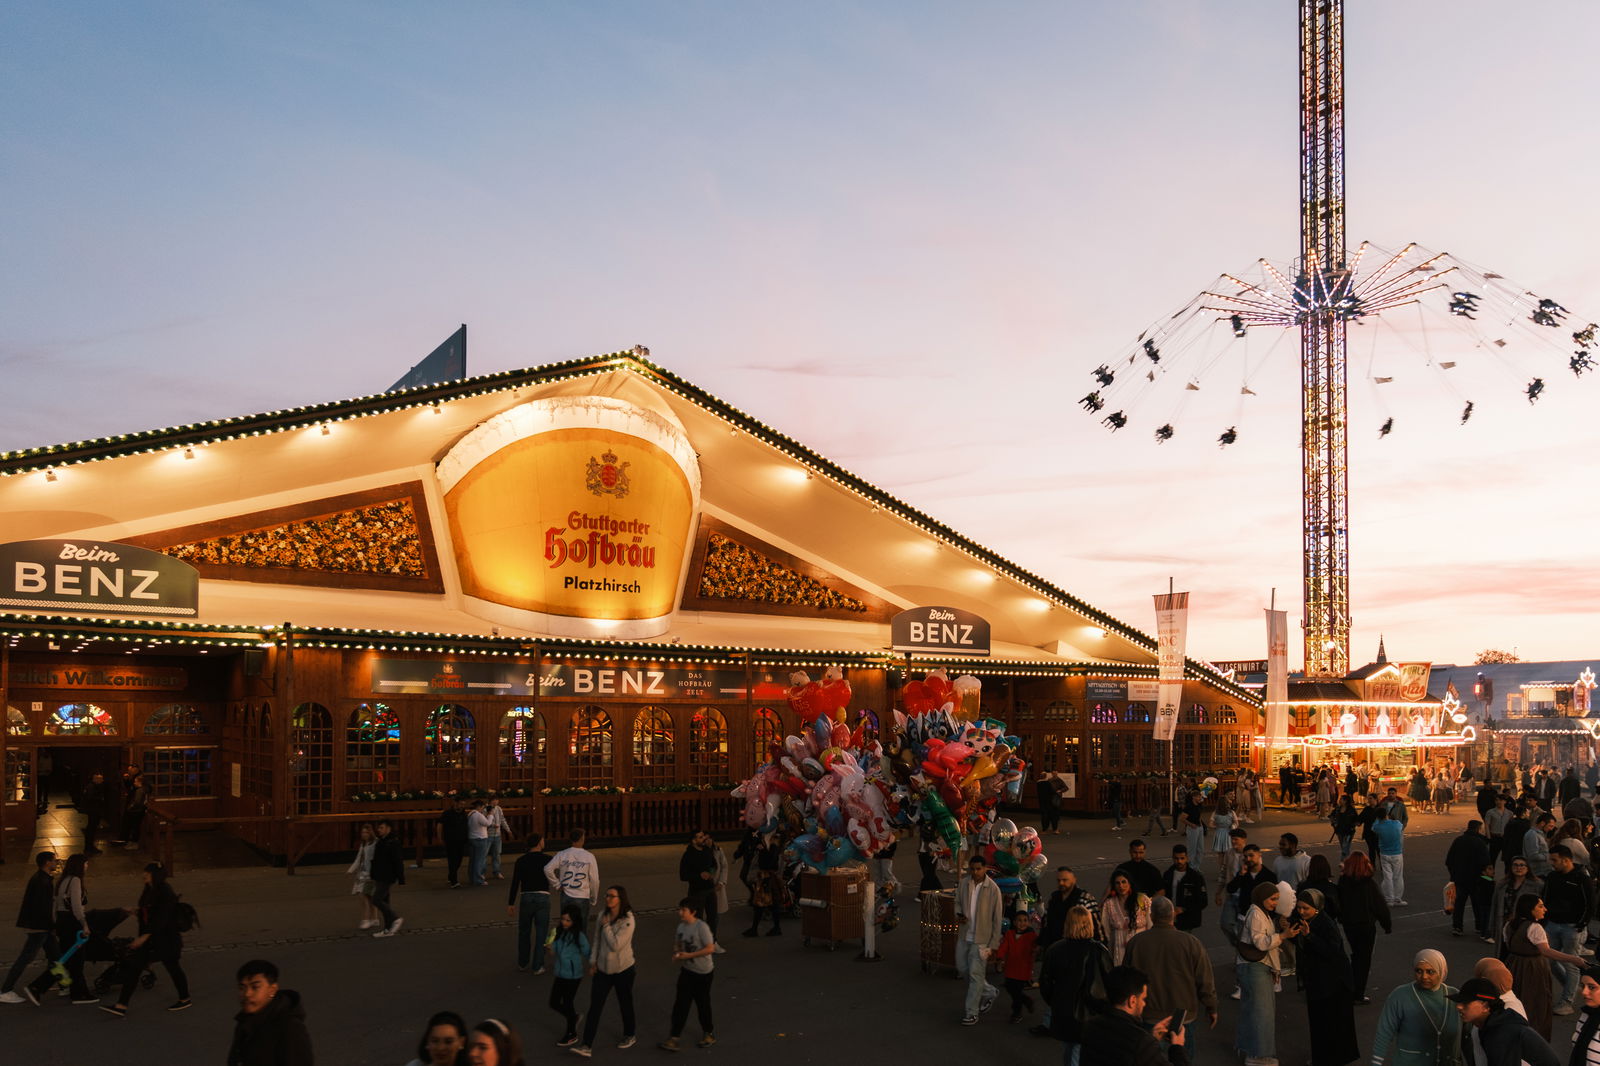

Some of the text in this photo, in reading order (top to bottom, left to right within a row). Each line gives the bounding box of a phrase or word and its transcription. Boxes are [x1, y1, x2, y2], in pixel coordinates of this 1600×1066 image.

[568, 510, 651, 536] Stuttgarter
[59, 543, 120, 563] Beim
[544, 527, 655, 569] Hofbräu
[15, 561, 160, 600] BENZ
[564, 576, 641, 593] Platzhirsch
[928, 608, 956, 621] Beim
[910, 621, 974, 645] BENZ
[1218, 661, 1260, 673] WASENWIRT
[64, 670, 180, 687] Willkommen
[525, 673, 566, 687] Beim
[574, 669, 665, 695] BENZ
[678, 679, 712, 688] HOFBRÄU
[1401, 685, 1426, 696] PIZZA
[560, 871, 586, 889] 23
